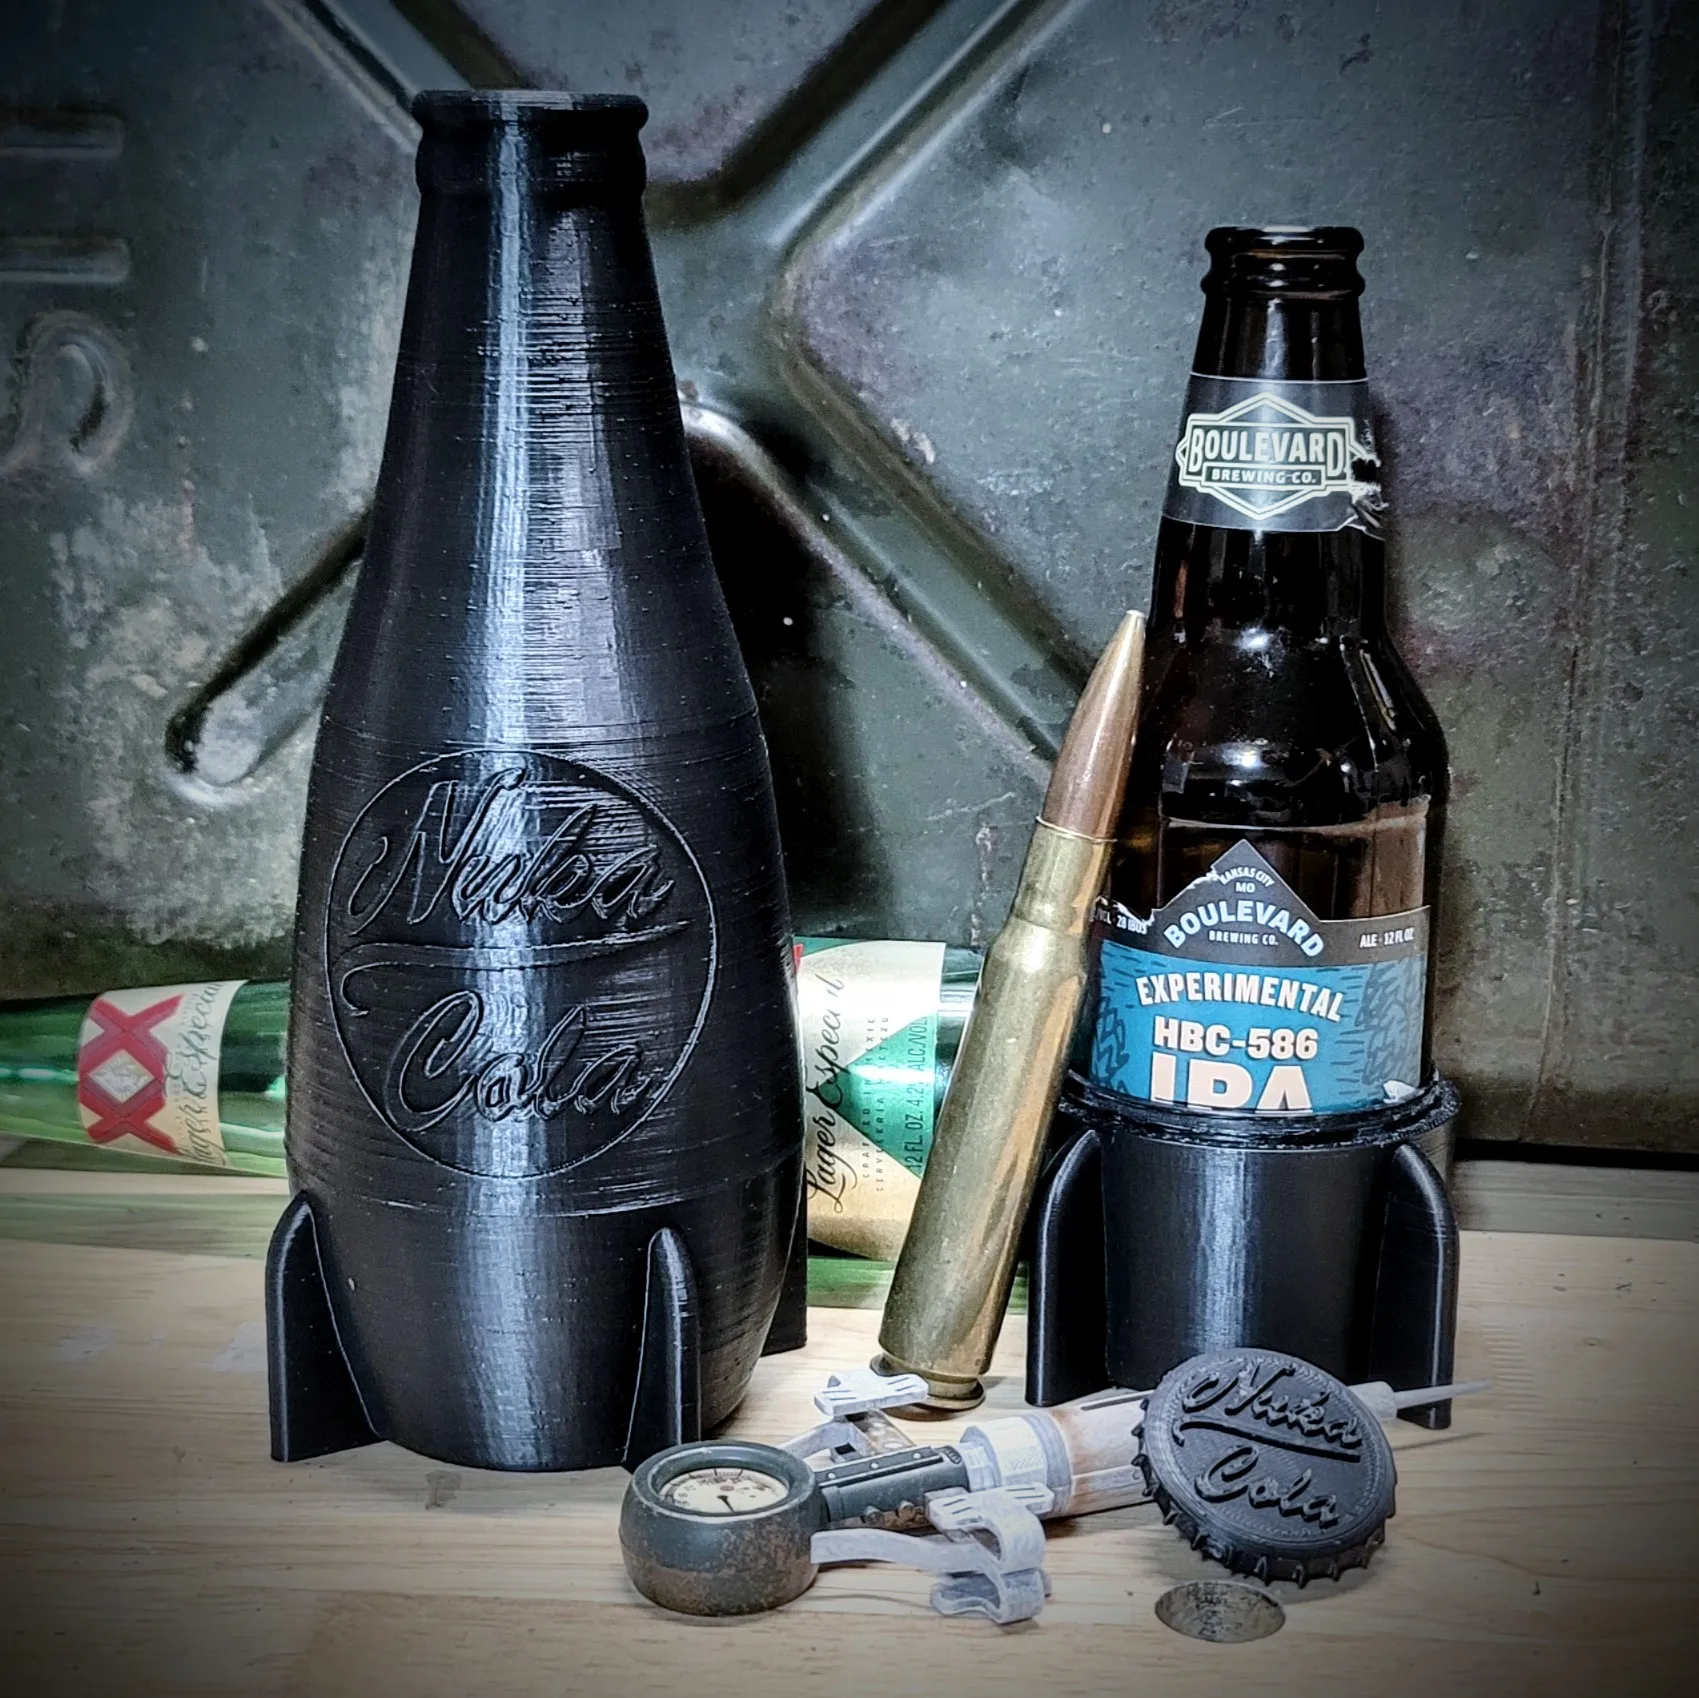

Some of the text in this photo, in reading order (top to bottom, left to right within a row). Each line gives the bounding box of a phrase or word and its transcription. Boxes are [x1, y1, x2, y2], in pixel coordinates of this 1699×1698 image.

[1188, 428, 1344, 477] BOULEVARD
[1211, 470, 1317, 484] BREWING CO.
[348, 766, 676, 937] Nuka
[1219, 867, 1276, 887] KANSAS CITY
[1235, 881, 1256, 893] MO
[1163, 900, 1324, 957] BOULEVARD
[1208, 930, 1279, 946] BREWING CO.
[1359, 933, 1378, 948] ALE
[1383, 930, 1395, 946] 12
[1136, 972, 1345, 1022] EXPERIMENTAL
[1154, 1016, 1319, 1060] HBC-586
[384, 990, 655, 1132] Cola
[804, 972, 858, 1214] Lager Especil
[904, 1110, 924, 1131] OZ.
[903, 1135, 925, 1153] FL.
[903, 1155, 924, 1168] 12
[1181, 1364, 1364, 1450] Nuka
[1194, 1444, 1341, 1530] Cola
